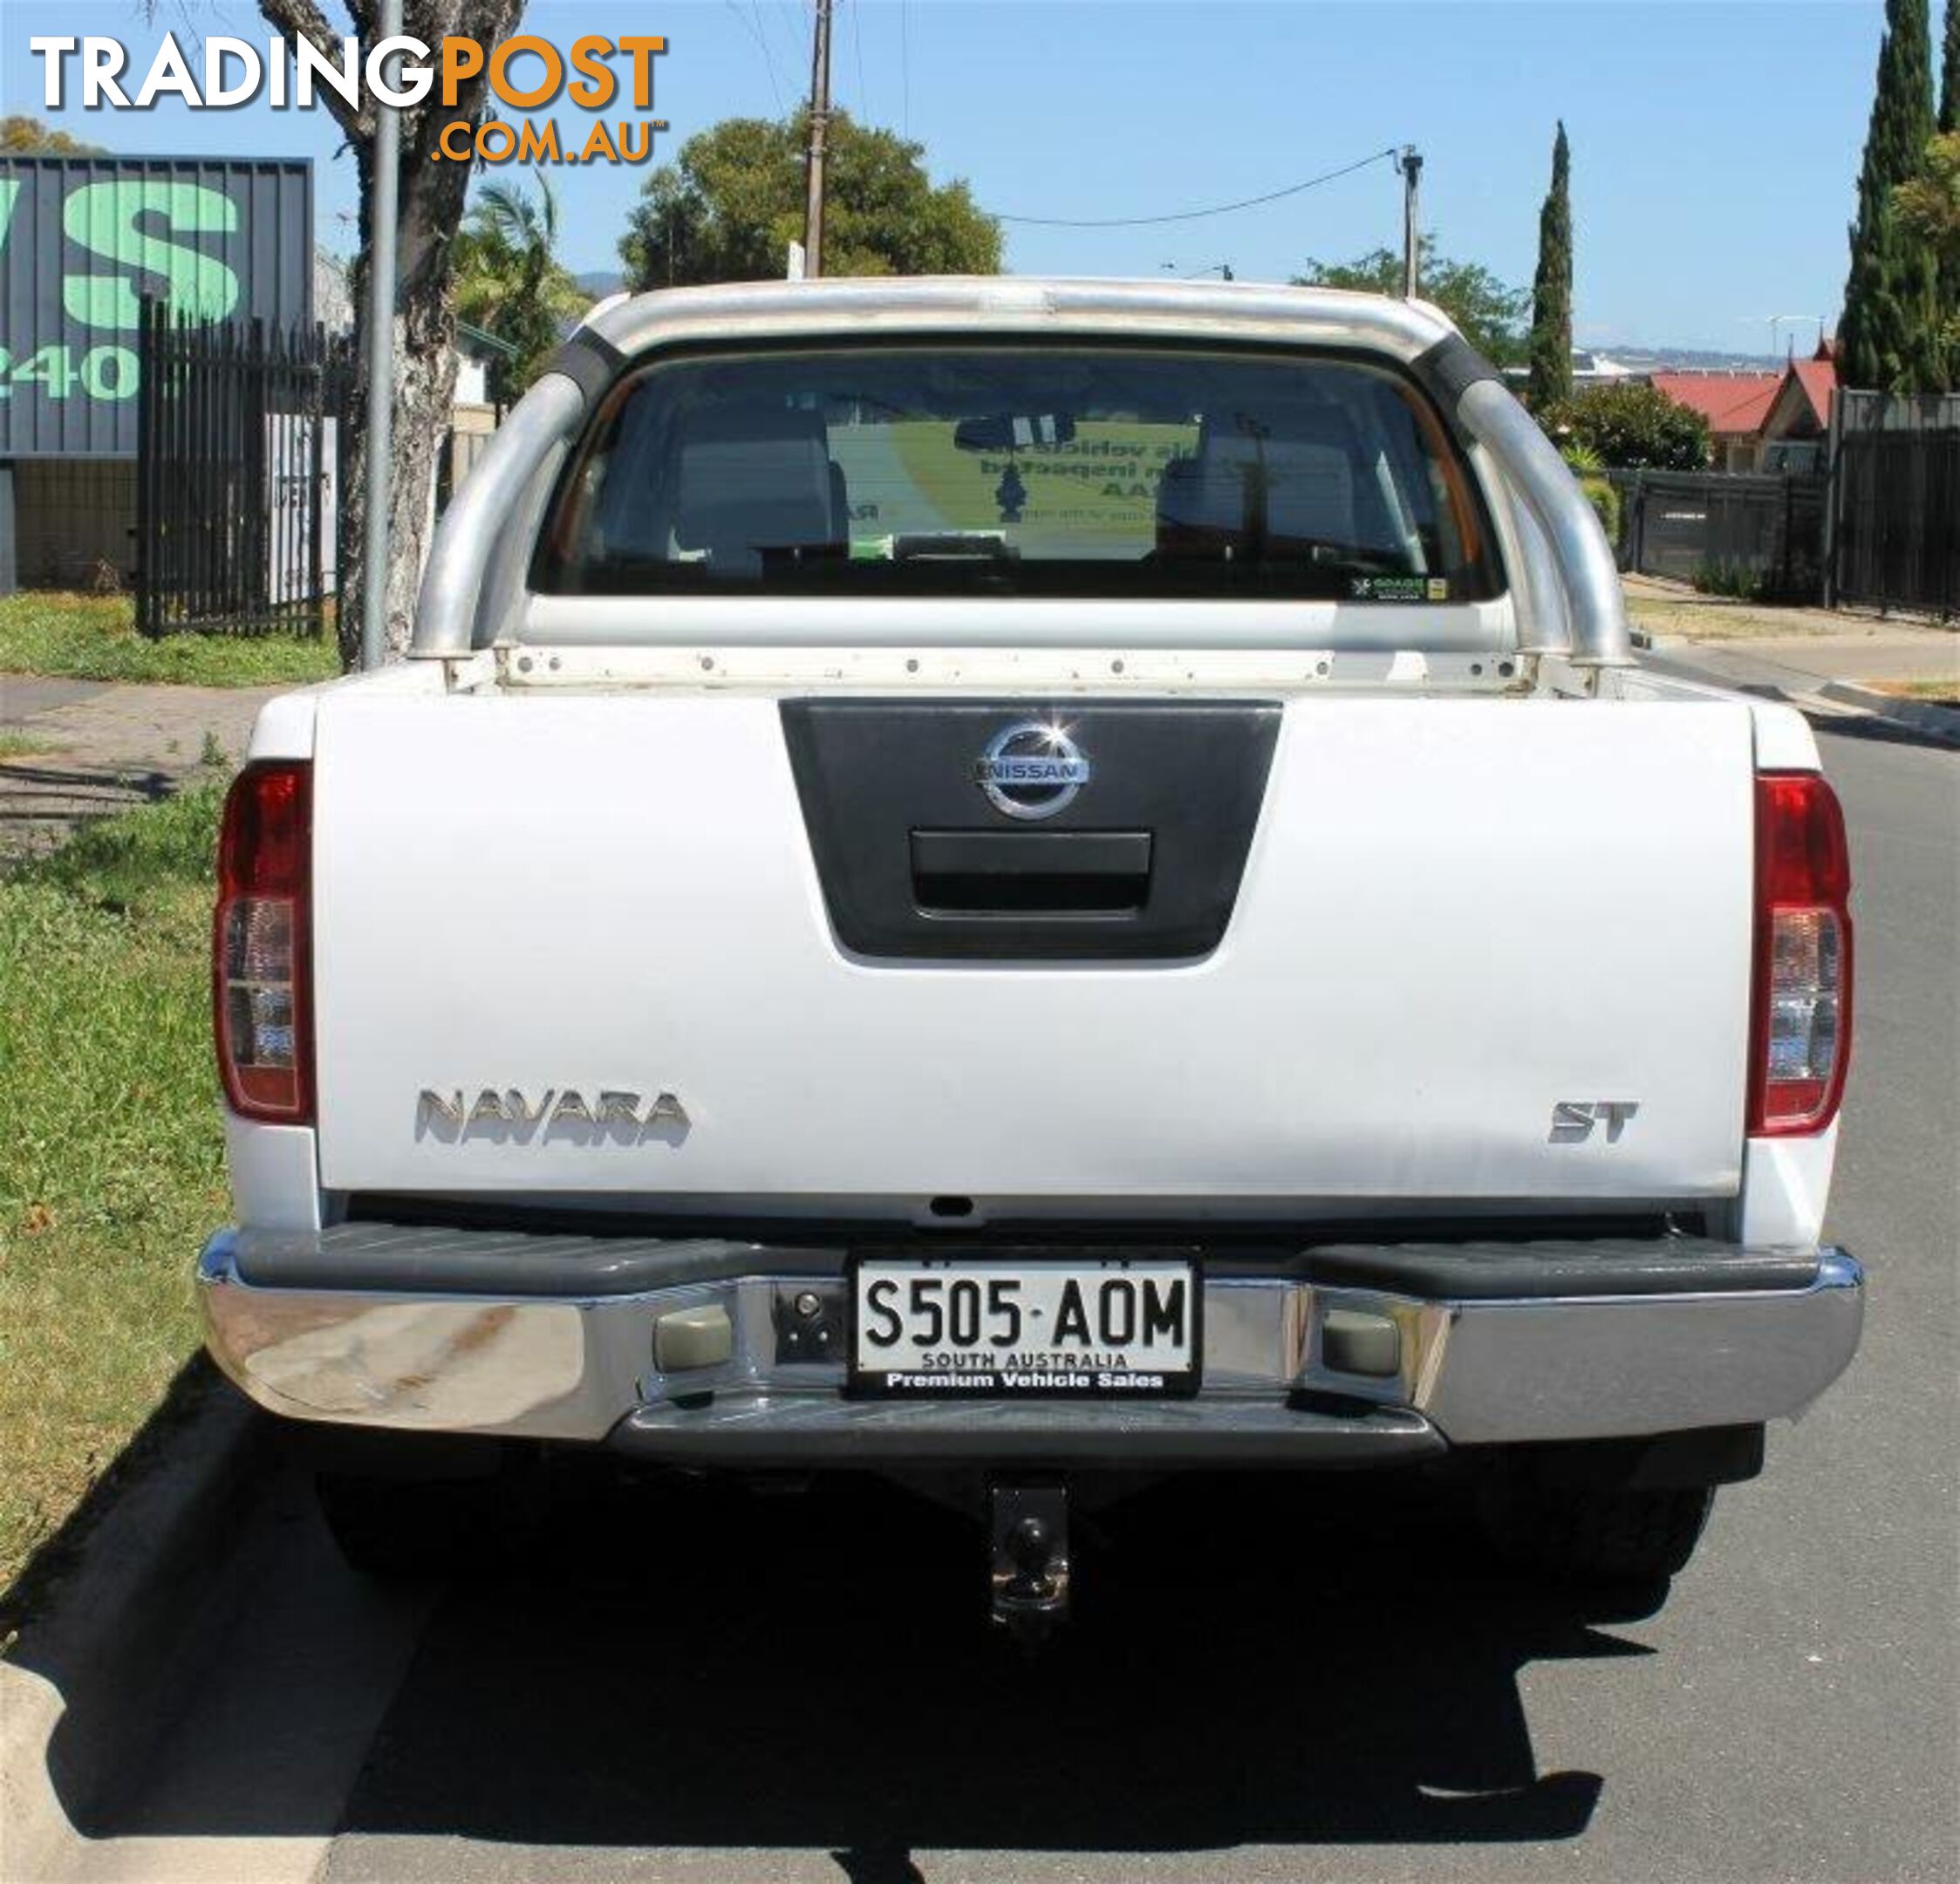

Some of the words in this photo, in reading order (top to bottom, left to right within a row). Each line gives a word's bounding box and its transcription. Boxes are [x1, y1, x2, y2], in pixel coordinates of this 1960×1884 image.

[0, 180, 238, 329] S
[0, 345, 141, 399] 40
[987, 764, 1078, 779] NISSAN
[414, 1089, 692, 1147] NAVARA
[1547, 1102, 1640, 1144] ST
[887, 1373, 994, 1388] Premium
[1001, 1373, 1090, 1388] Vehicle
[1097, 1373, 1164, 1388] Sales
[922, 1354, 995, 1369] SOUTH
[1005, 1354, 1128, 1369] AUSTRALIA
